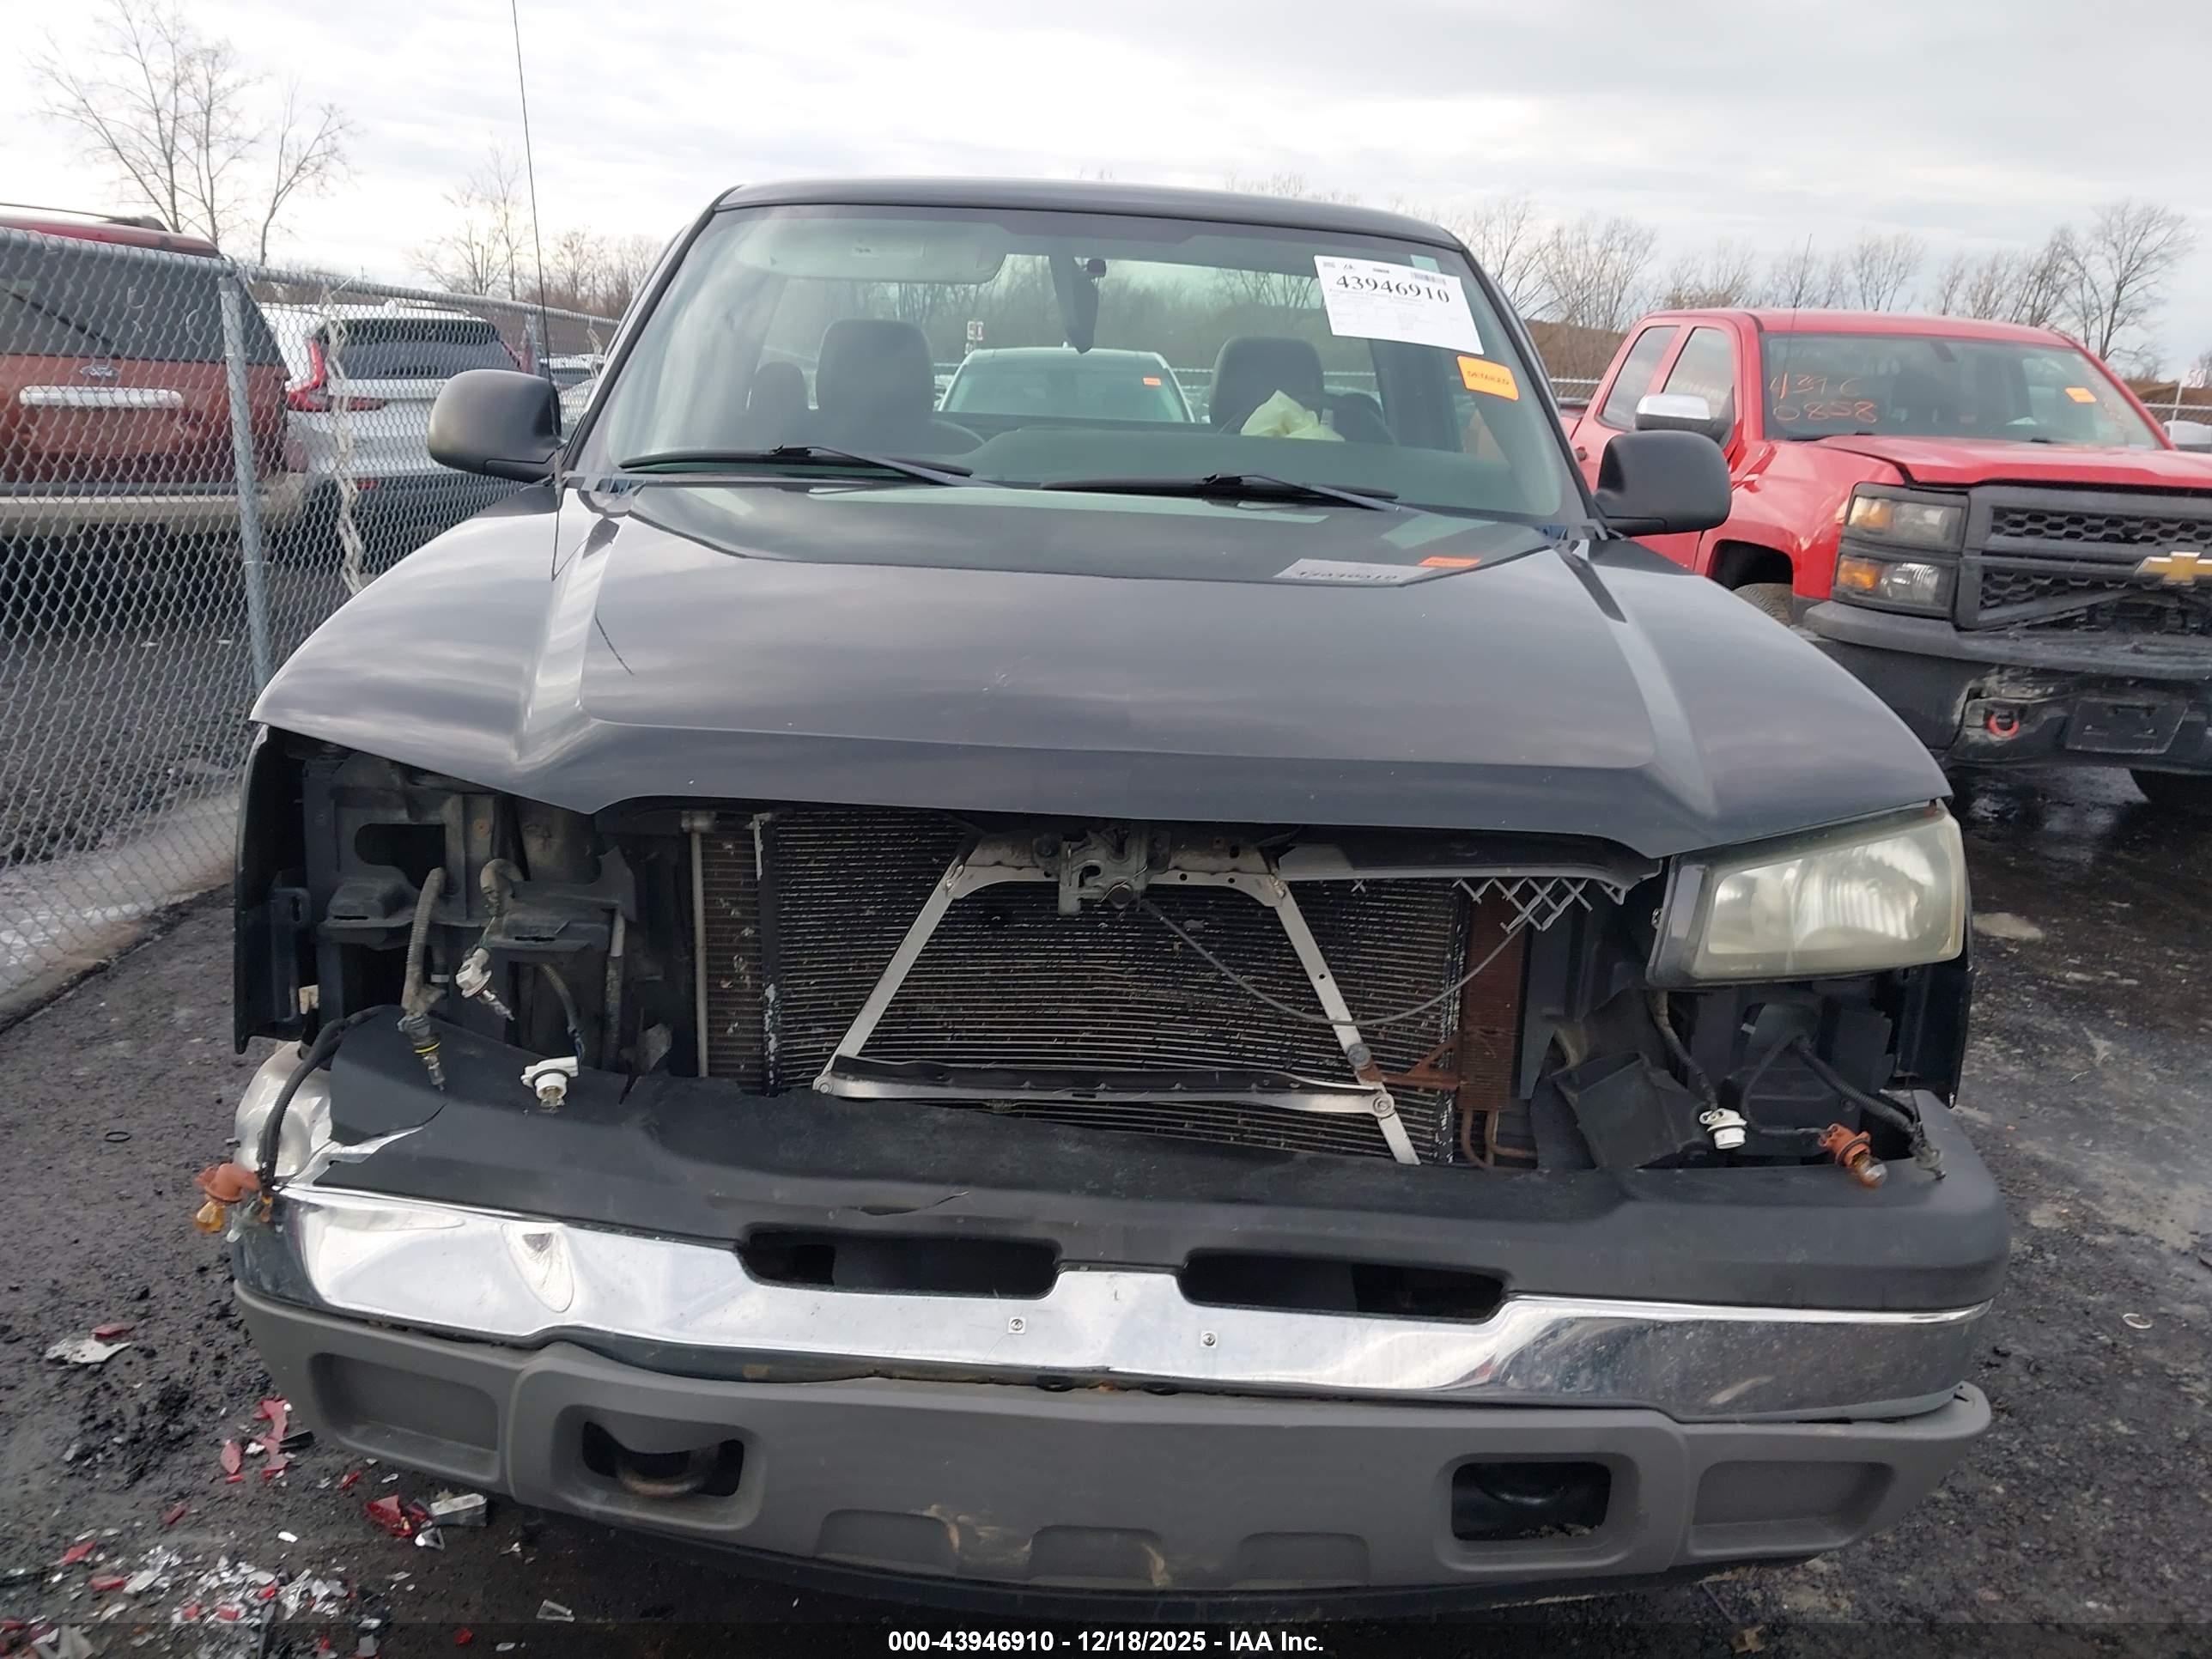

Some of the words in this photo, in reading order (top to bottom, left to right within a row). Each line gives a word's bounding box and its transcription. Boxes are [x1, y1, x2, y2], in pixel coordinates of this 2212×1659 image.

[1336, 274, 1450, 303] 43946910
[2186, 369, 2205, 386] 50
[1772, 400, 1877, 423] 0858
